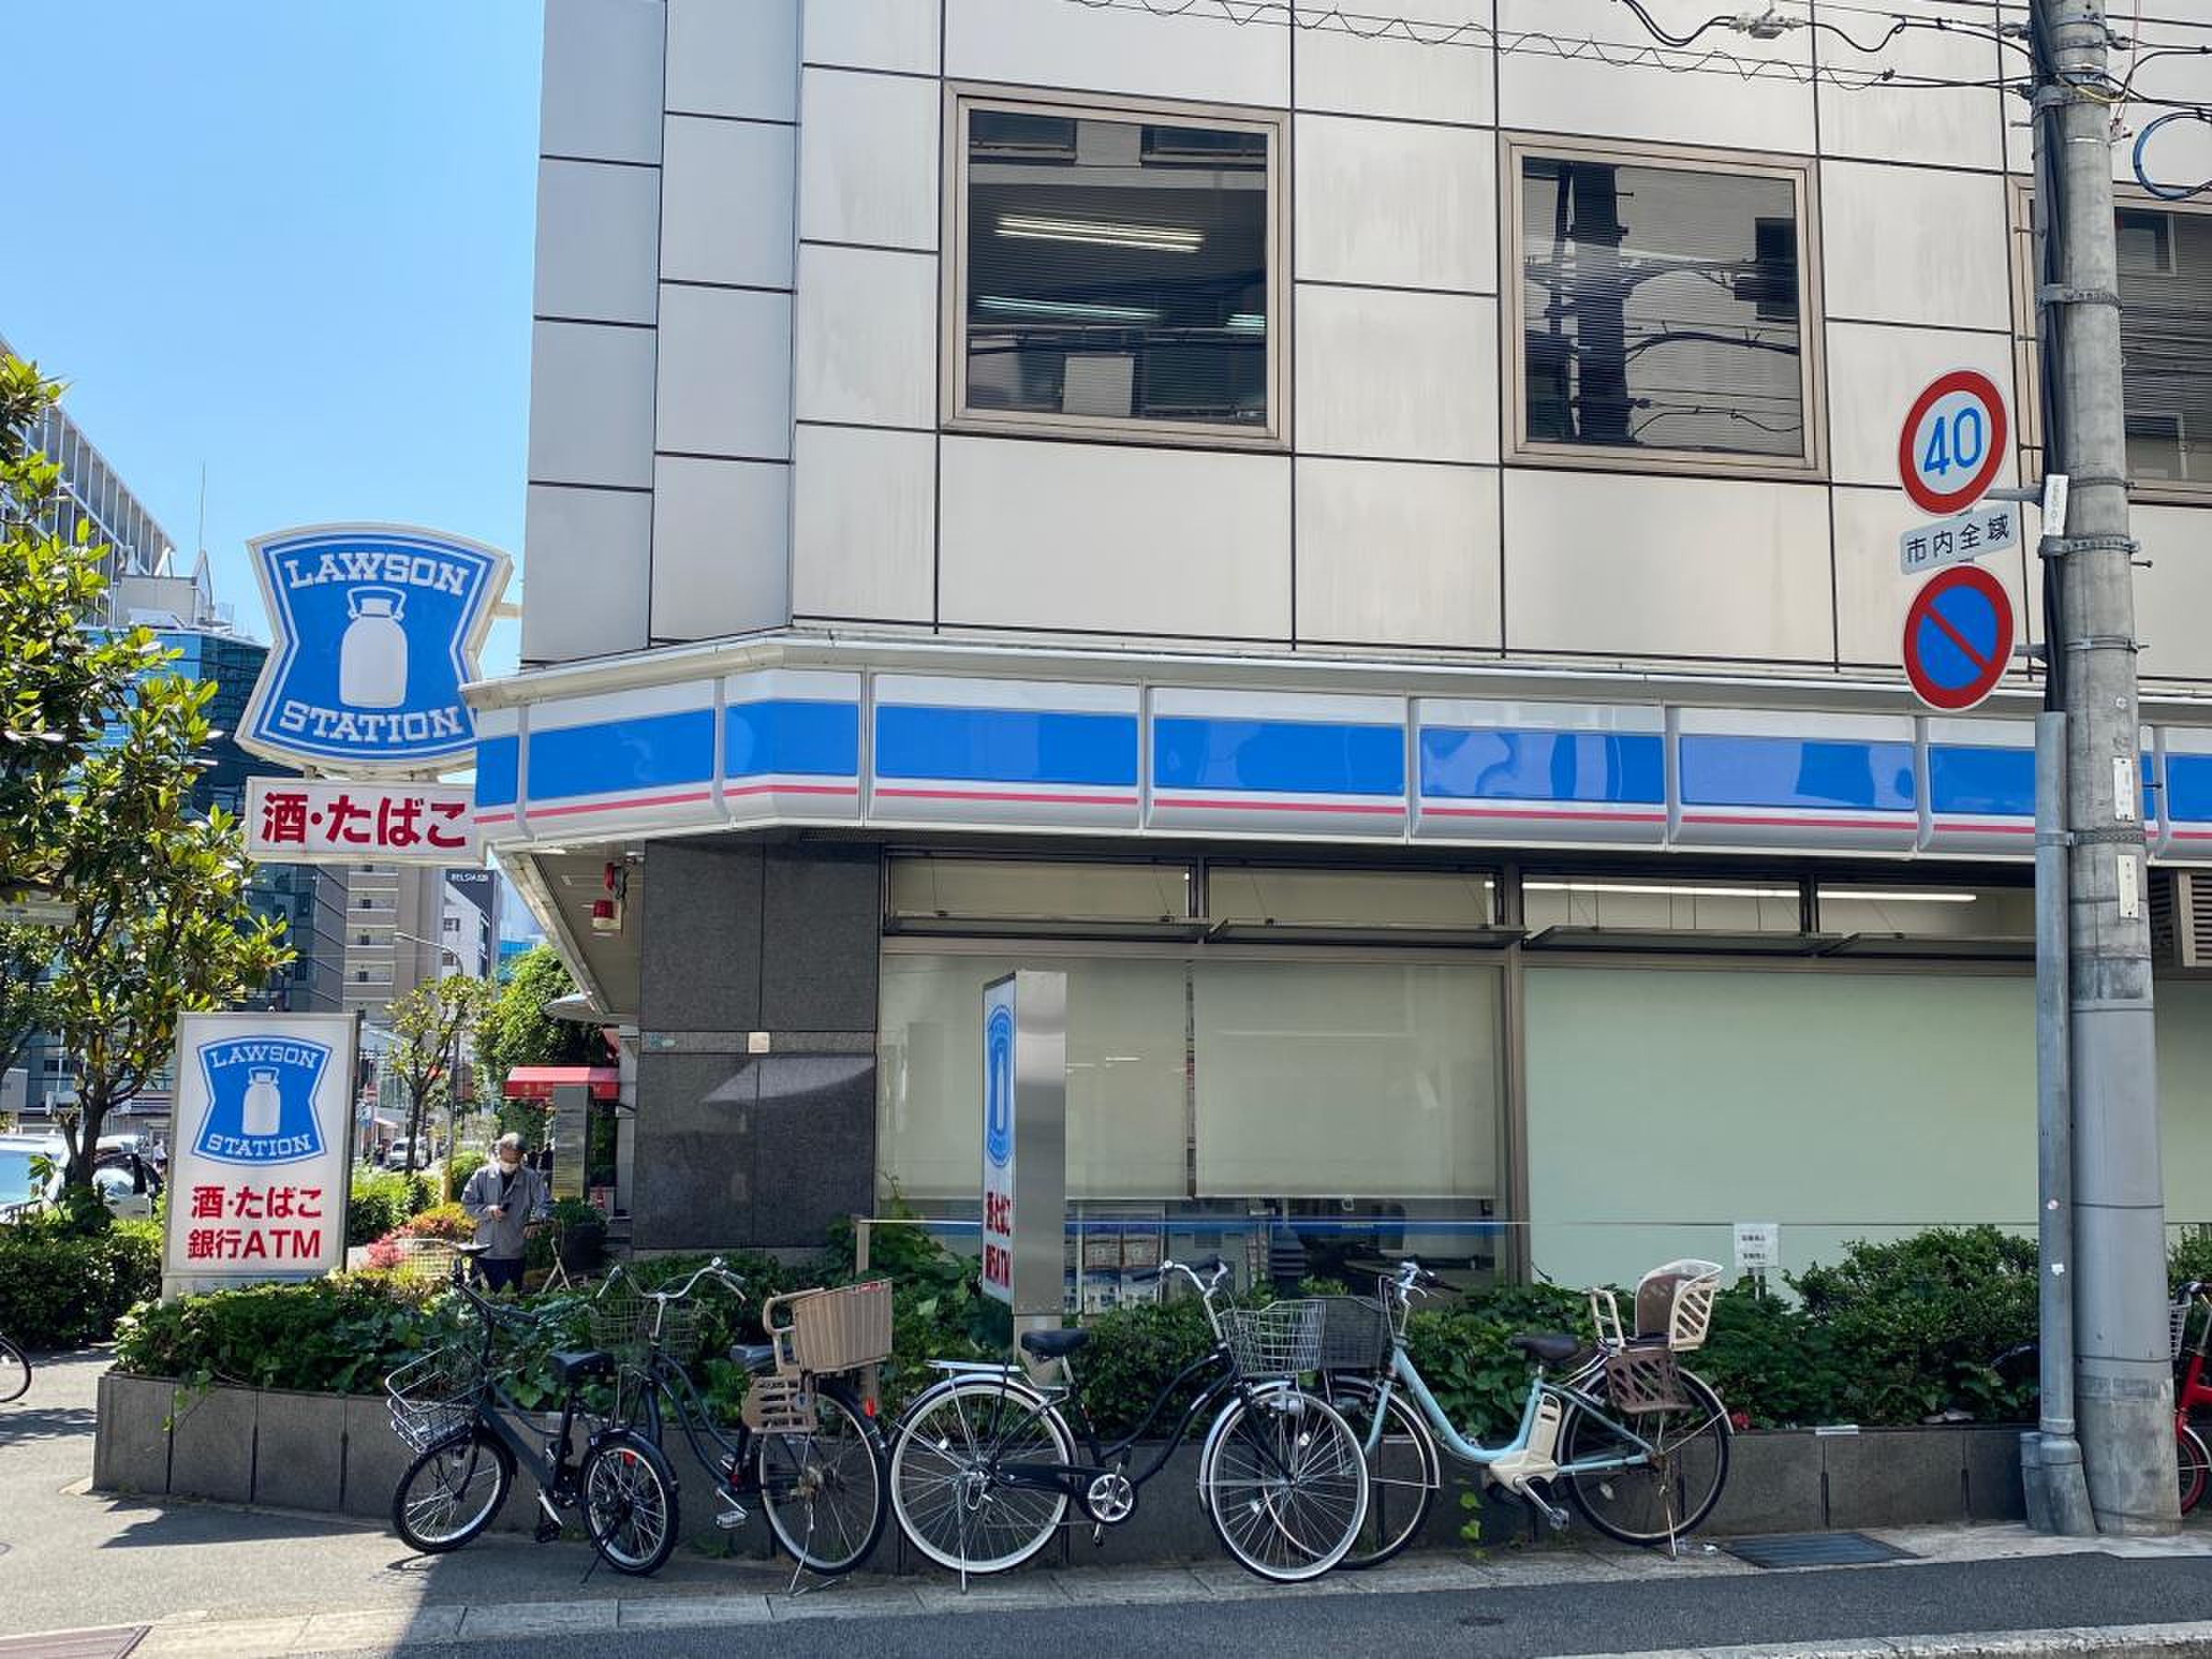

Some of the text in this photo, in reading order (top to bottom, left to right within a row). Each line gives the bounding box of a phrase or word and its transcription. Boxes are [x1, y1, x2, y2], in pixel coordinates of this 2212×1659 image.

[1924, 407, 1982, 475] 40
[1907, 513, 2009, 563] 市内全域
[285, 553, 468, 595] LAWSON
[278, 700, 460, 744] STATION
[261, 791, 466, 848] 酒・たばこ
[211, 1045, 318, 1068] LAWSON
[207, 1134, 311, 1157] STATION
[191, 1185, 323, 1218] 酒・たばこ
[187, 1229, 321, 1260] 銀行ATM
